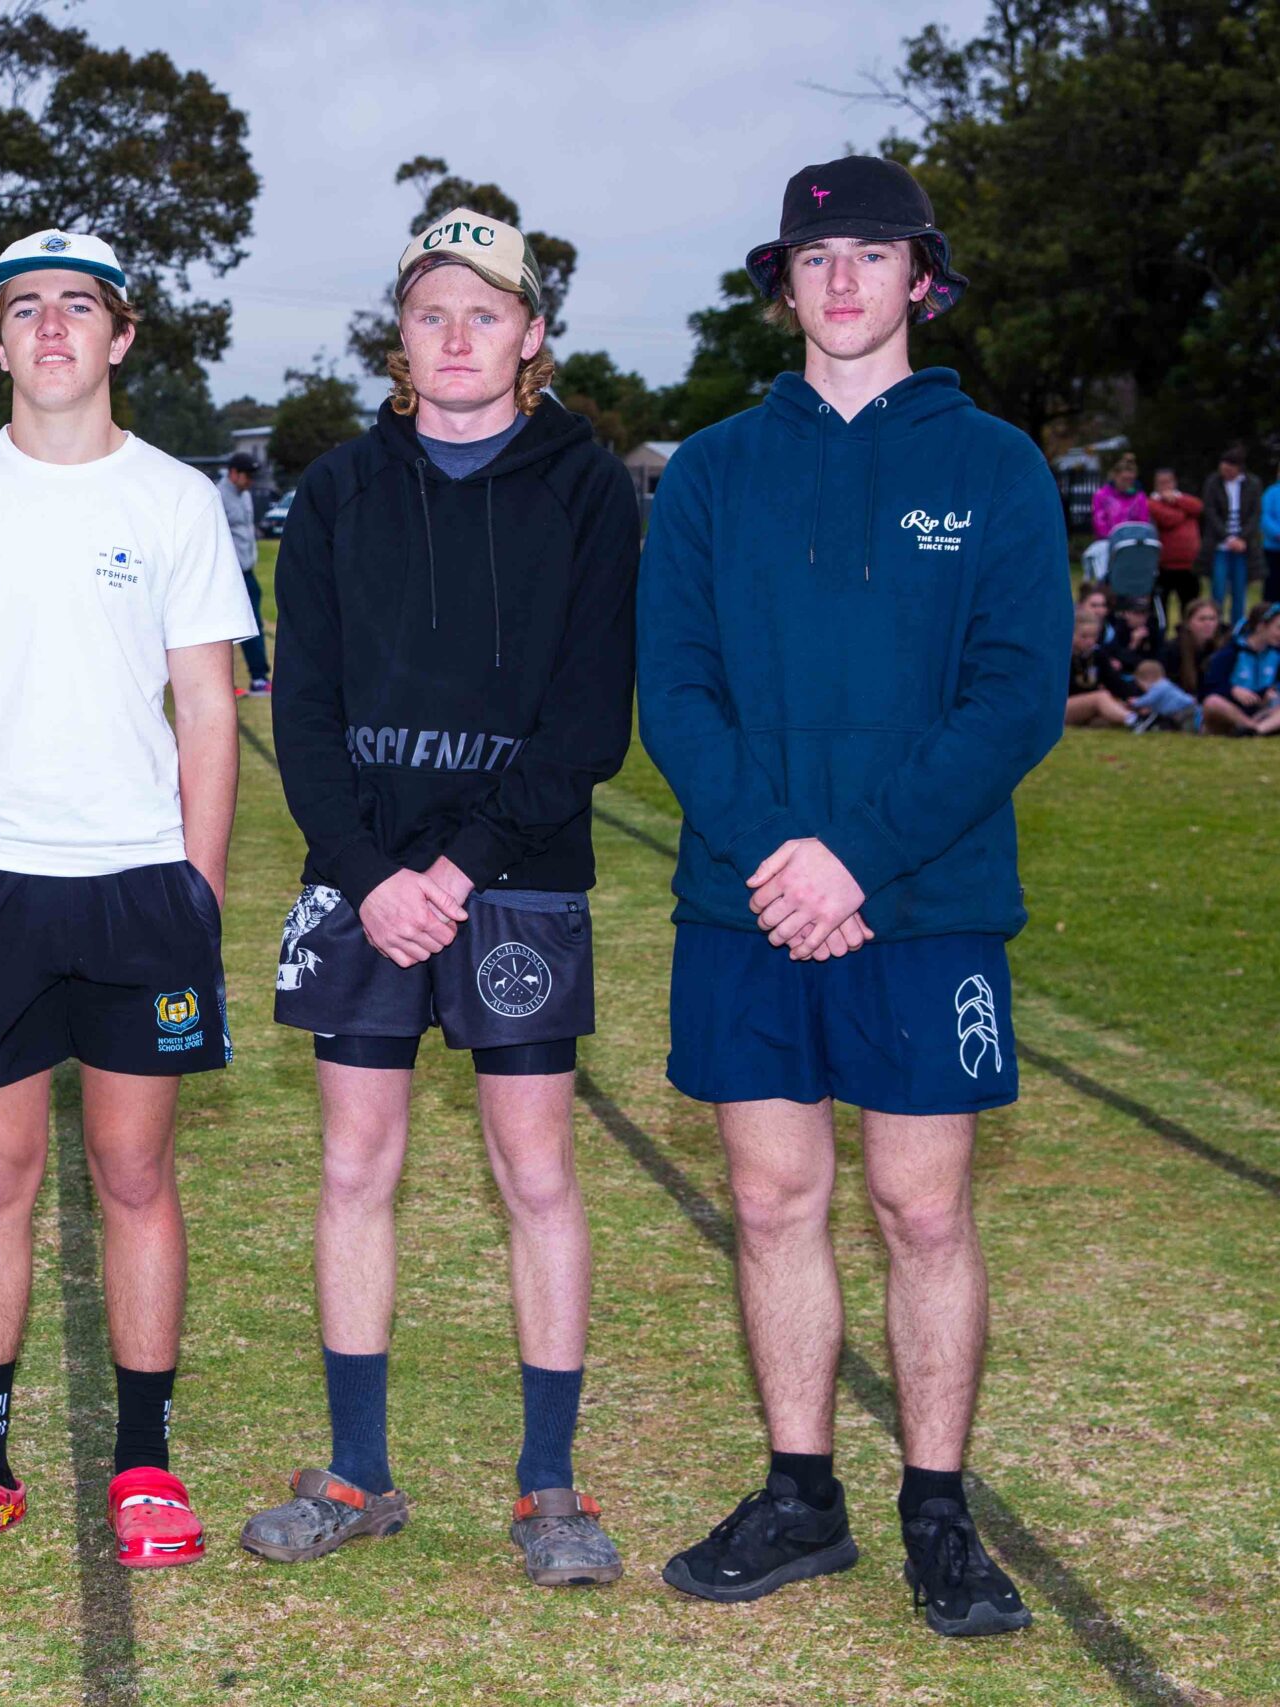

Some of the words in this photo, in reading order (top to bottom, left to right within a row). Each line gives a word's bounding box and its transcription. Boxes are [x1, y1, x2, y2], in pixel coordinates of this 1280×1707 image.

[423, 222, 495, 250] CTC
[900, 509, 940, 534] Rip
[943, 510, 973, 532] Curl
[918, 543, 943, 551] SINCE
[943, 544, 960, 552] 1969
[934, 536, 962, 544] SEARCH
[95, 568, 139, 584] STSHHSE
[481, 956, 496, 977] PIG
[496, 945, 545, 971] CHASING
[489, 994, 545, 1015] AUSTRALIA
[158, 1037, 184, 1046] NORTH
[184, 1030, 204, 1042] WEST
[158, 1043, 185, 1053] SCHOOL
[184, 1039, 204, 1050] SPORT
